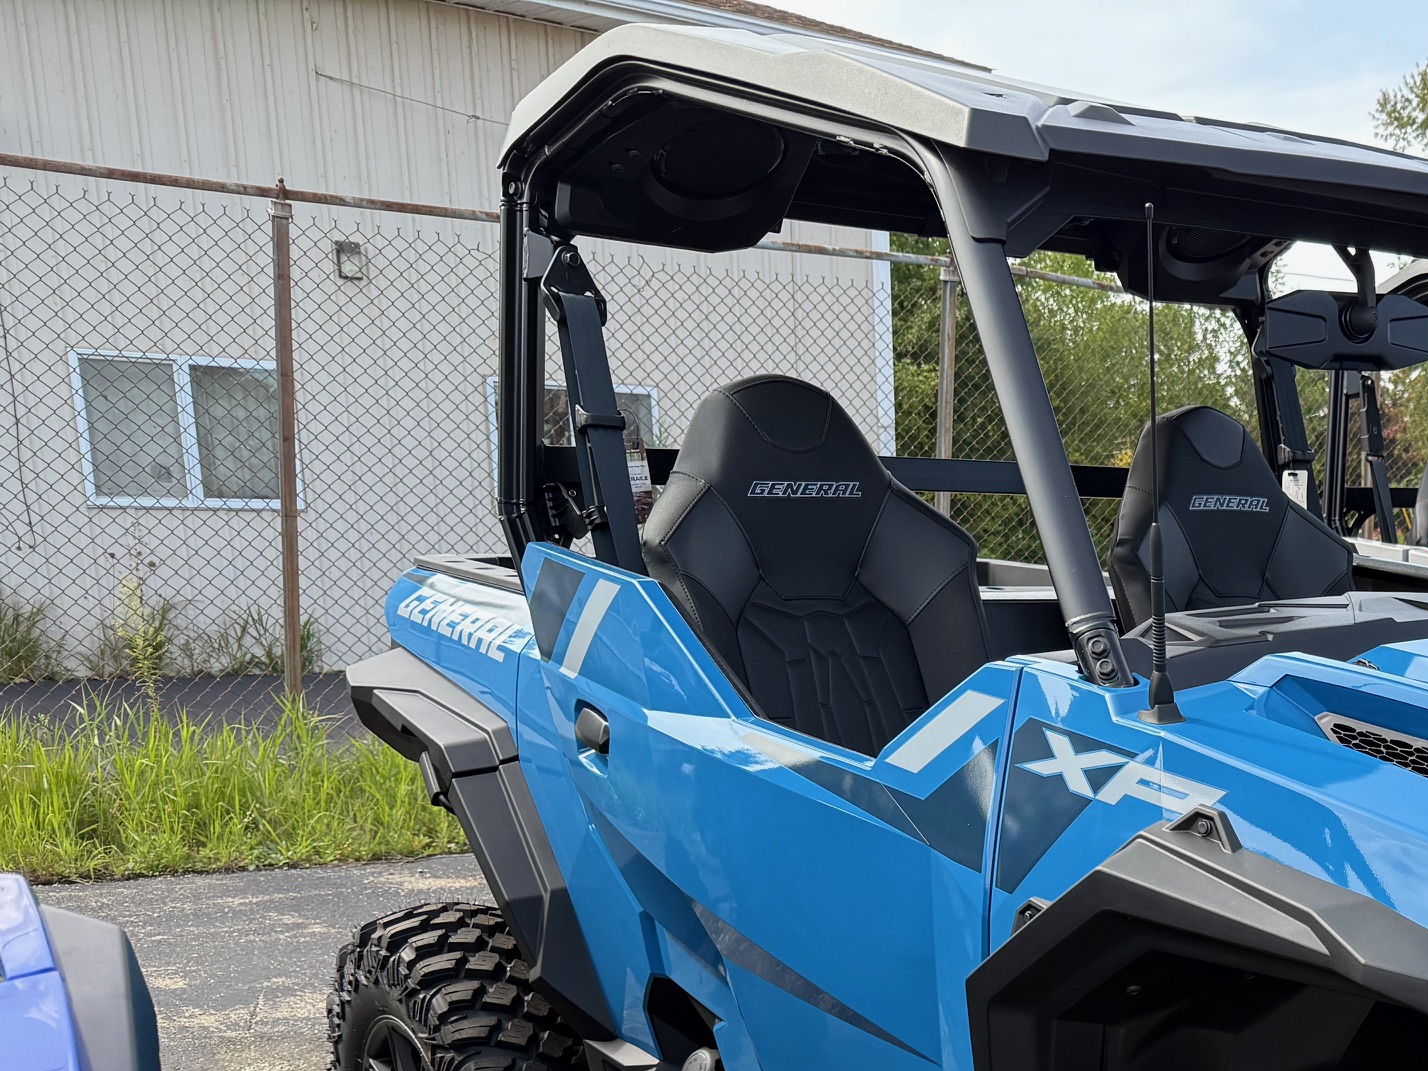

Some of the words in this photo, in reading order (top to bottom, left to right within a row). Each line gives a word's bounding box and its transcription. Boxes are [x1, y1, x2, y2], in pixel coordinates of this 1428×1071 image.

[748, 481, 861, 497] GENERAL
[1190, 495, 1269, 512] GENERAL
[397, 586, 521, 663] GENERAL
[1015, 727, 1229, 815] XP
